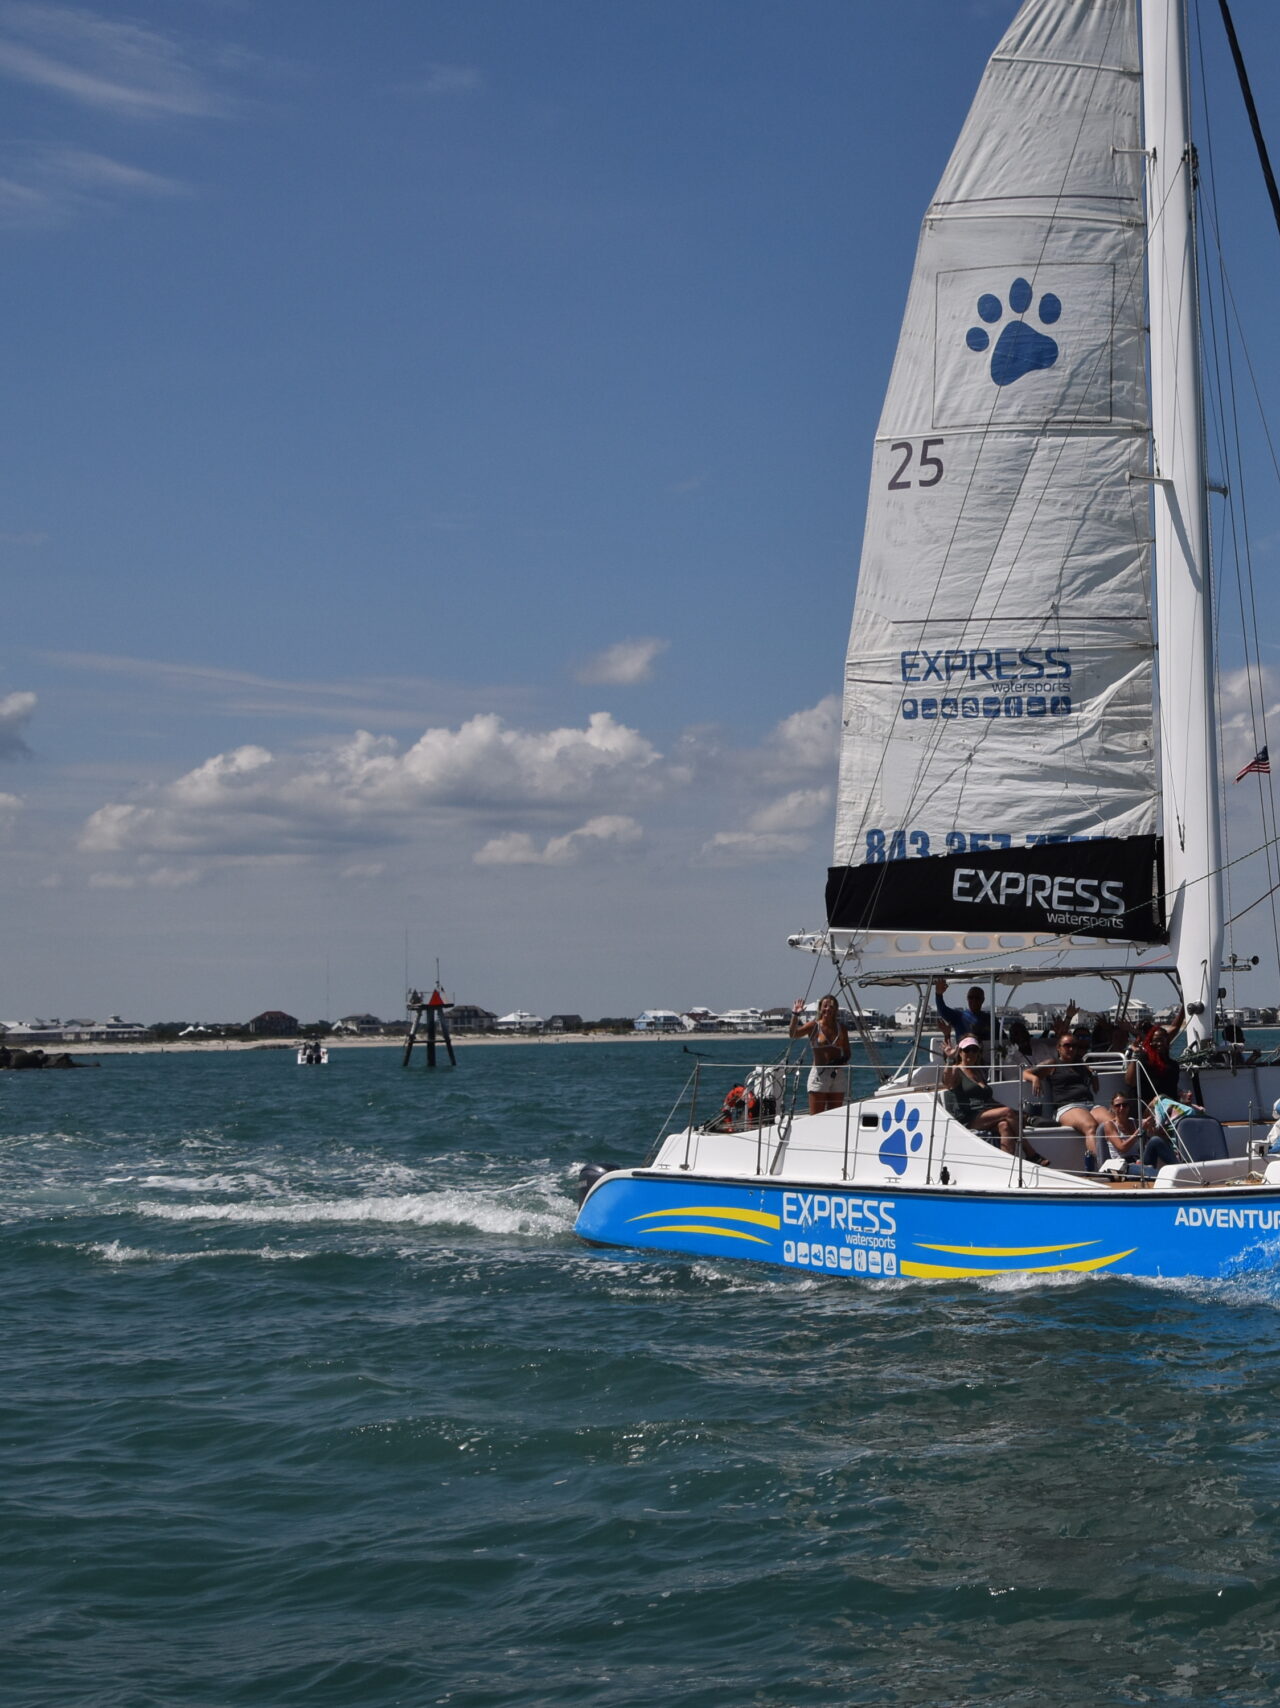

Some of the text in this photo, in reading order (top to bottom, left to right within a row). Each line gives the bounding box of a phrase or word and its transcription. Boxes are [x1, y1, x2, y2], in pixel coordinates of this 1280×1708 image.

[888, 438, 944, 490] 25
[901, 647, 1072, 681] EXPRESS
[992, 681, 1071, 695] watersports
[952, 868, 1126, 915] EXPRESS
[1046, 912, 1124, 929] watersports
[783, 1191, 897, 1235] EXPRESS
[845, 1233, 896, 1249] watersports
